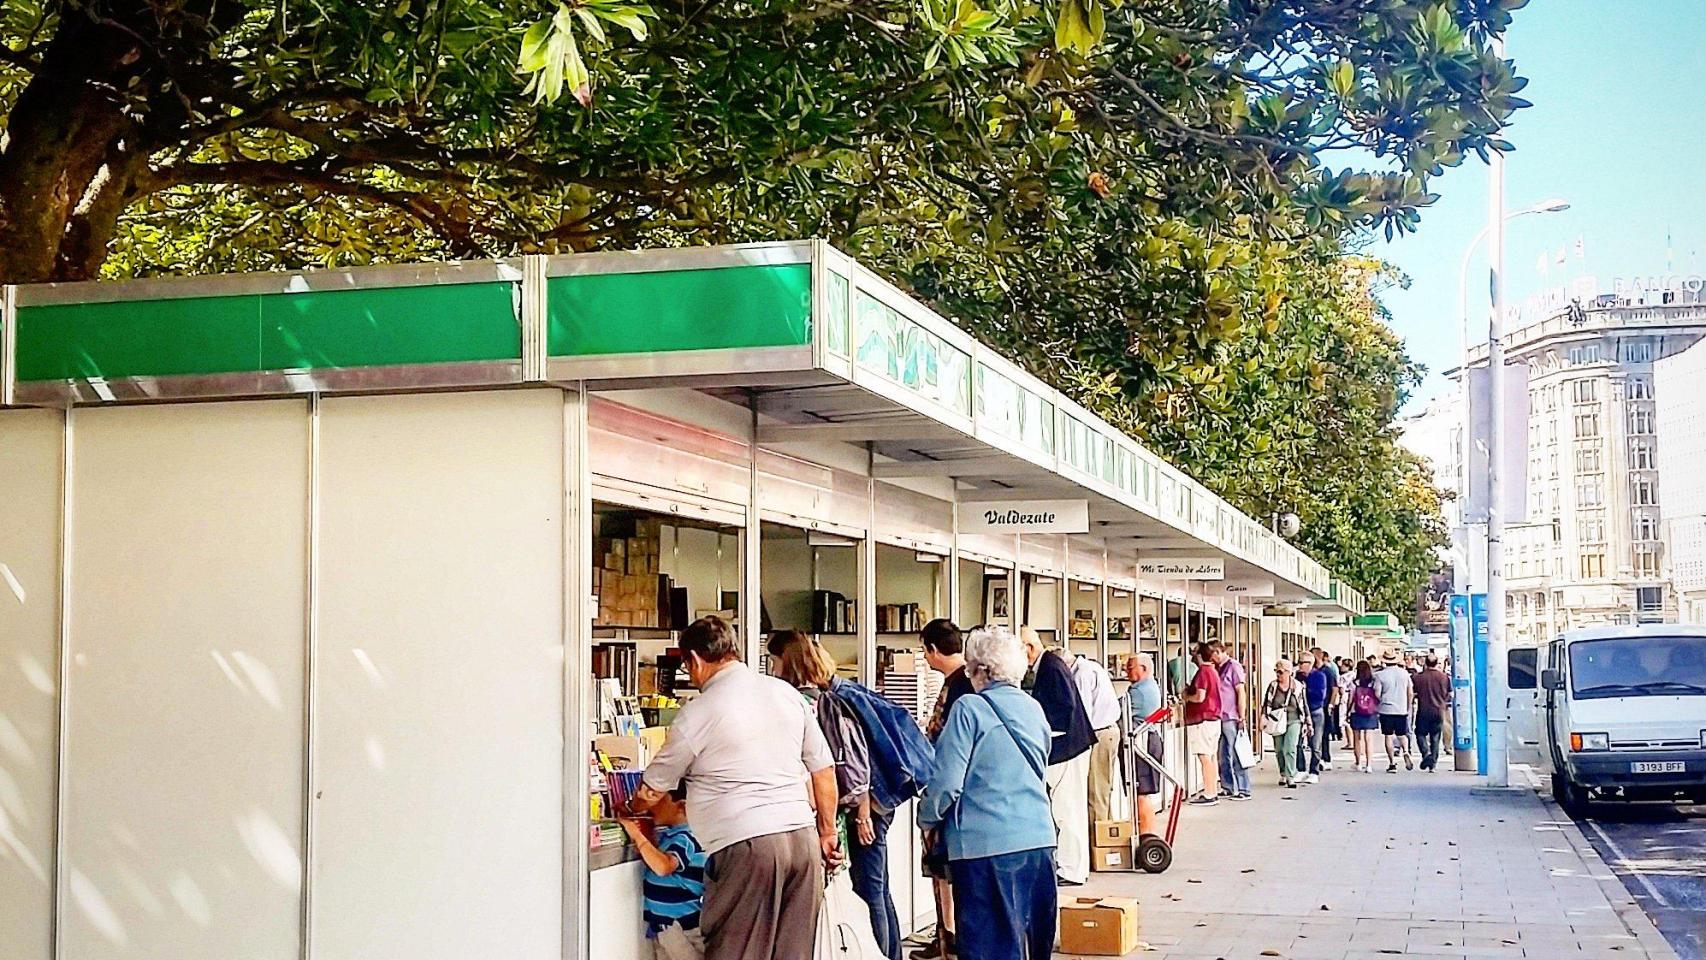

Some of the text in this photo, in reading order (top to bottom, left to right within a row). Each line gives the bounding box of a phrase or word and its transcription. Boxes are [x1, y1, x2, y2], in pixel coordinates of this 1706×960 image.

[984, 510, 1055, 524] Valdezate
[1157, 564, 1183, 573] Tienda
[1185, 564, 1194, 573] de
[1639, 762, 1683, 772] 3193 BFF
